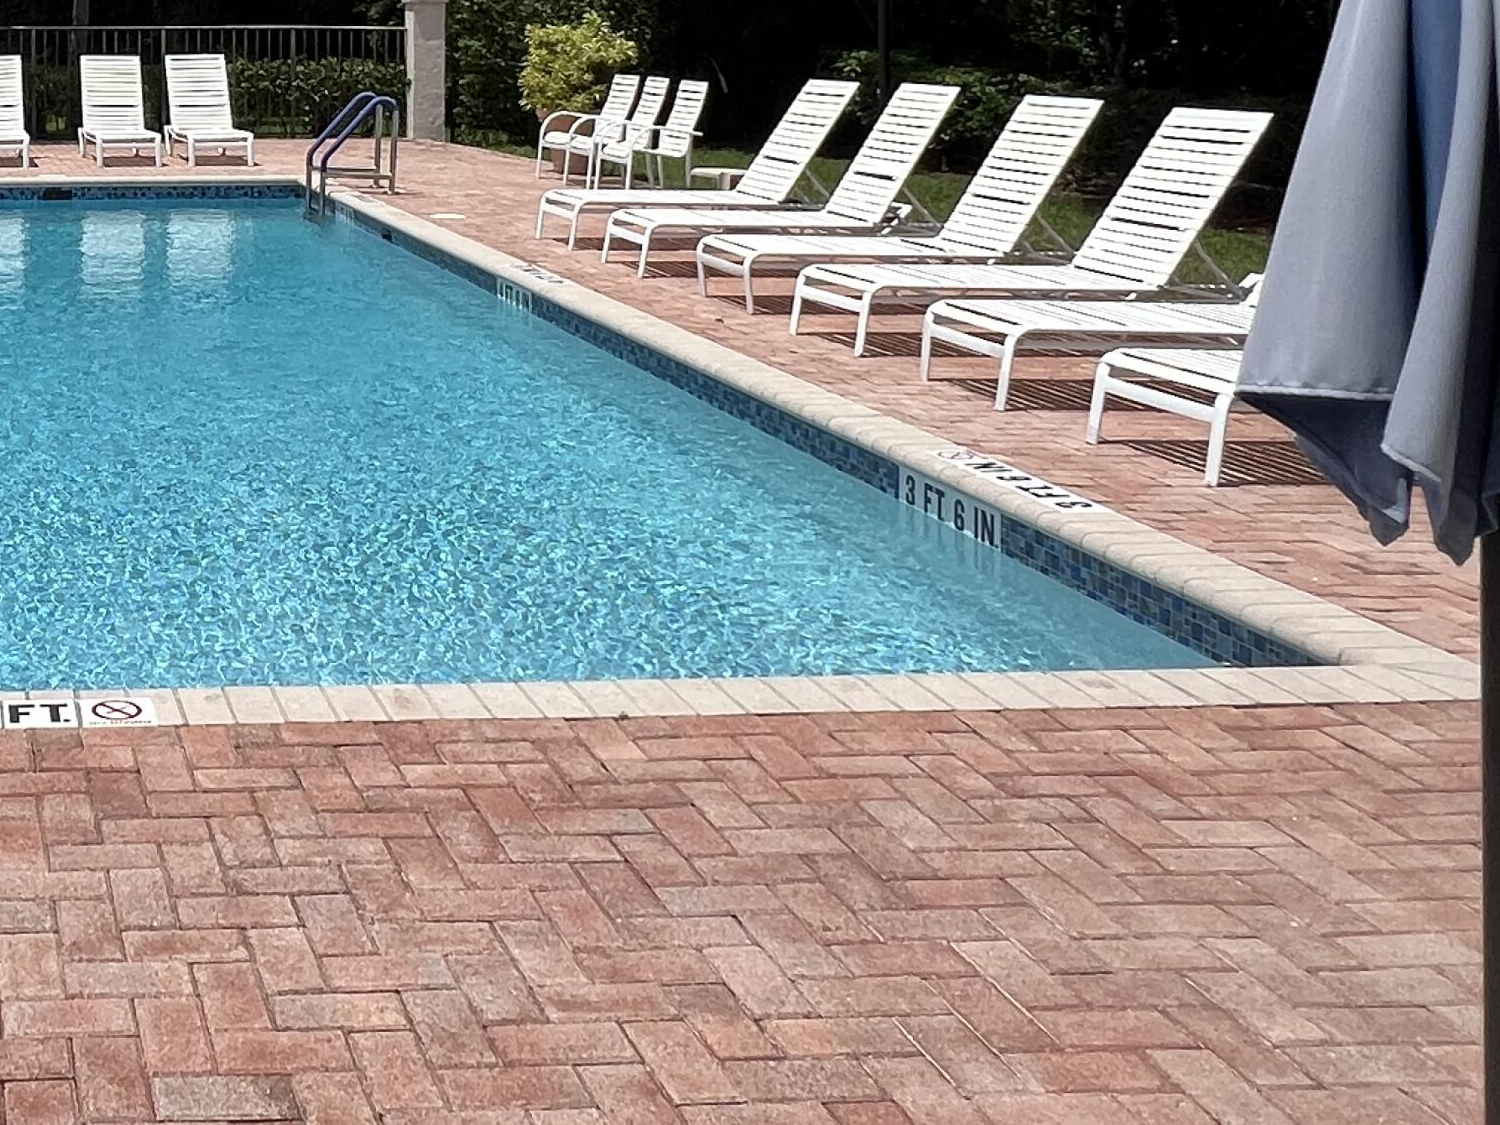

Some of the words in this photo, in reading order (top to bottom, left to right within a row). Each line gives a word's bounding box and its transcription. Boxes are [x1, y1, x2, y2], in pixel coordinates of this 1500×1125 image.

[906, 475, 916, 505] 3
[954, 498, 965, 531] 6
[8, 703, 71, 724] FT.
